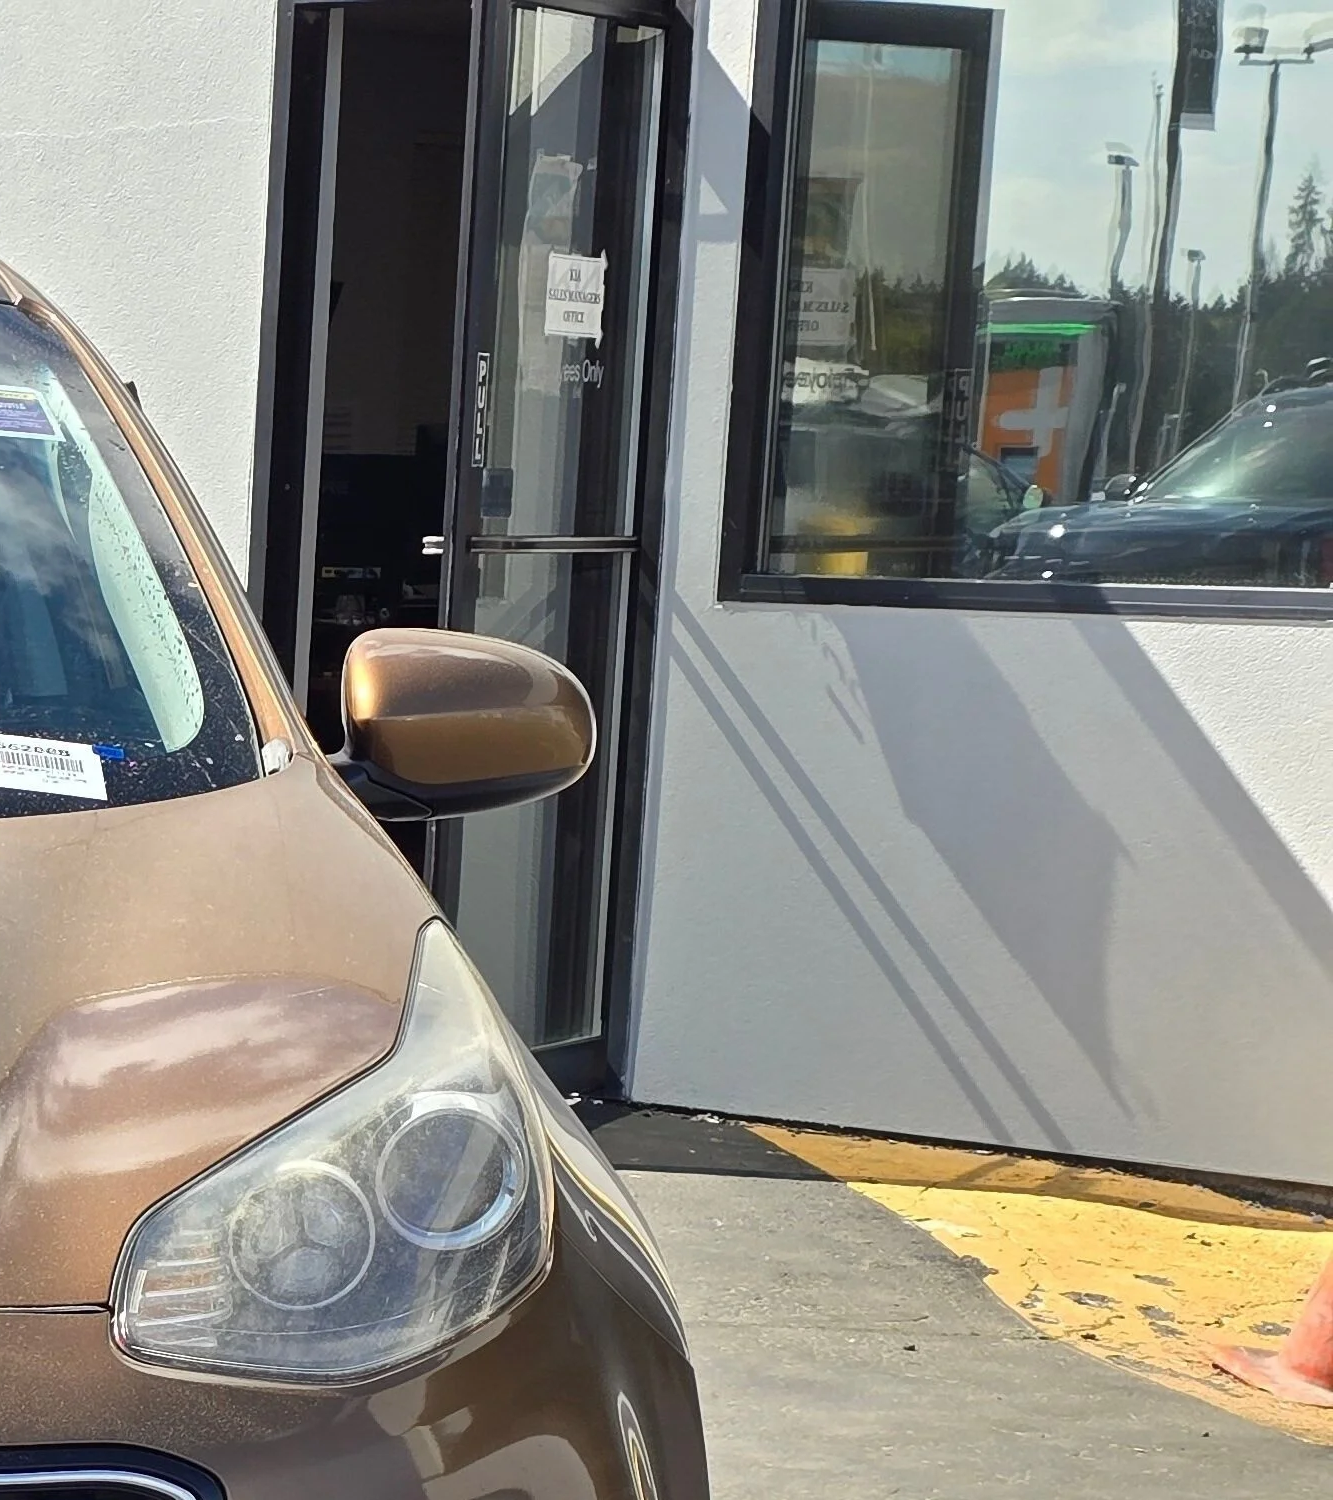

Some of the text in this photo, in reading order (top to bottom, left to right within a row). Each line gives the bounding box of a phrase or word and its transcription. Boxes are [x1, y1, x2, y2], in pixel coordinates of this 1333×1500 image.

[548, 287, 567, 301] SALES
[563, 310, 585, 323] OFFICE
[582, 359, 605, 389] Only
[474, 360, 487, 460] PULL
